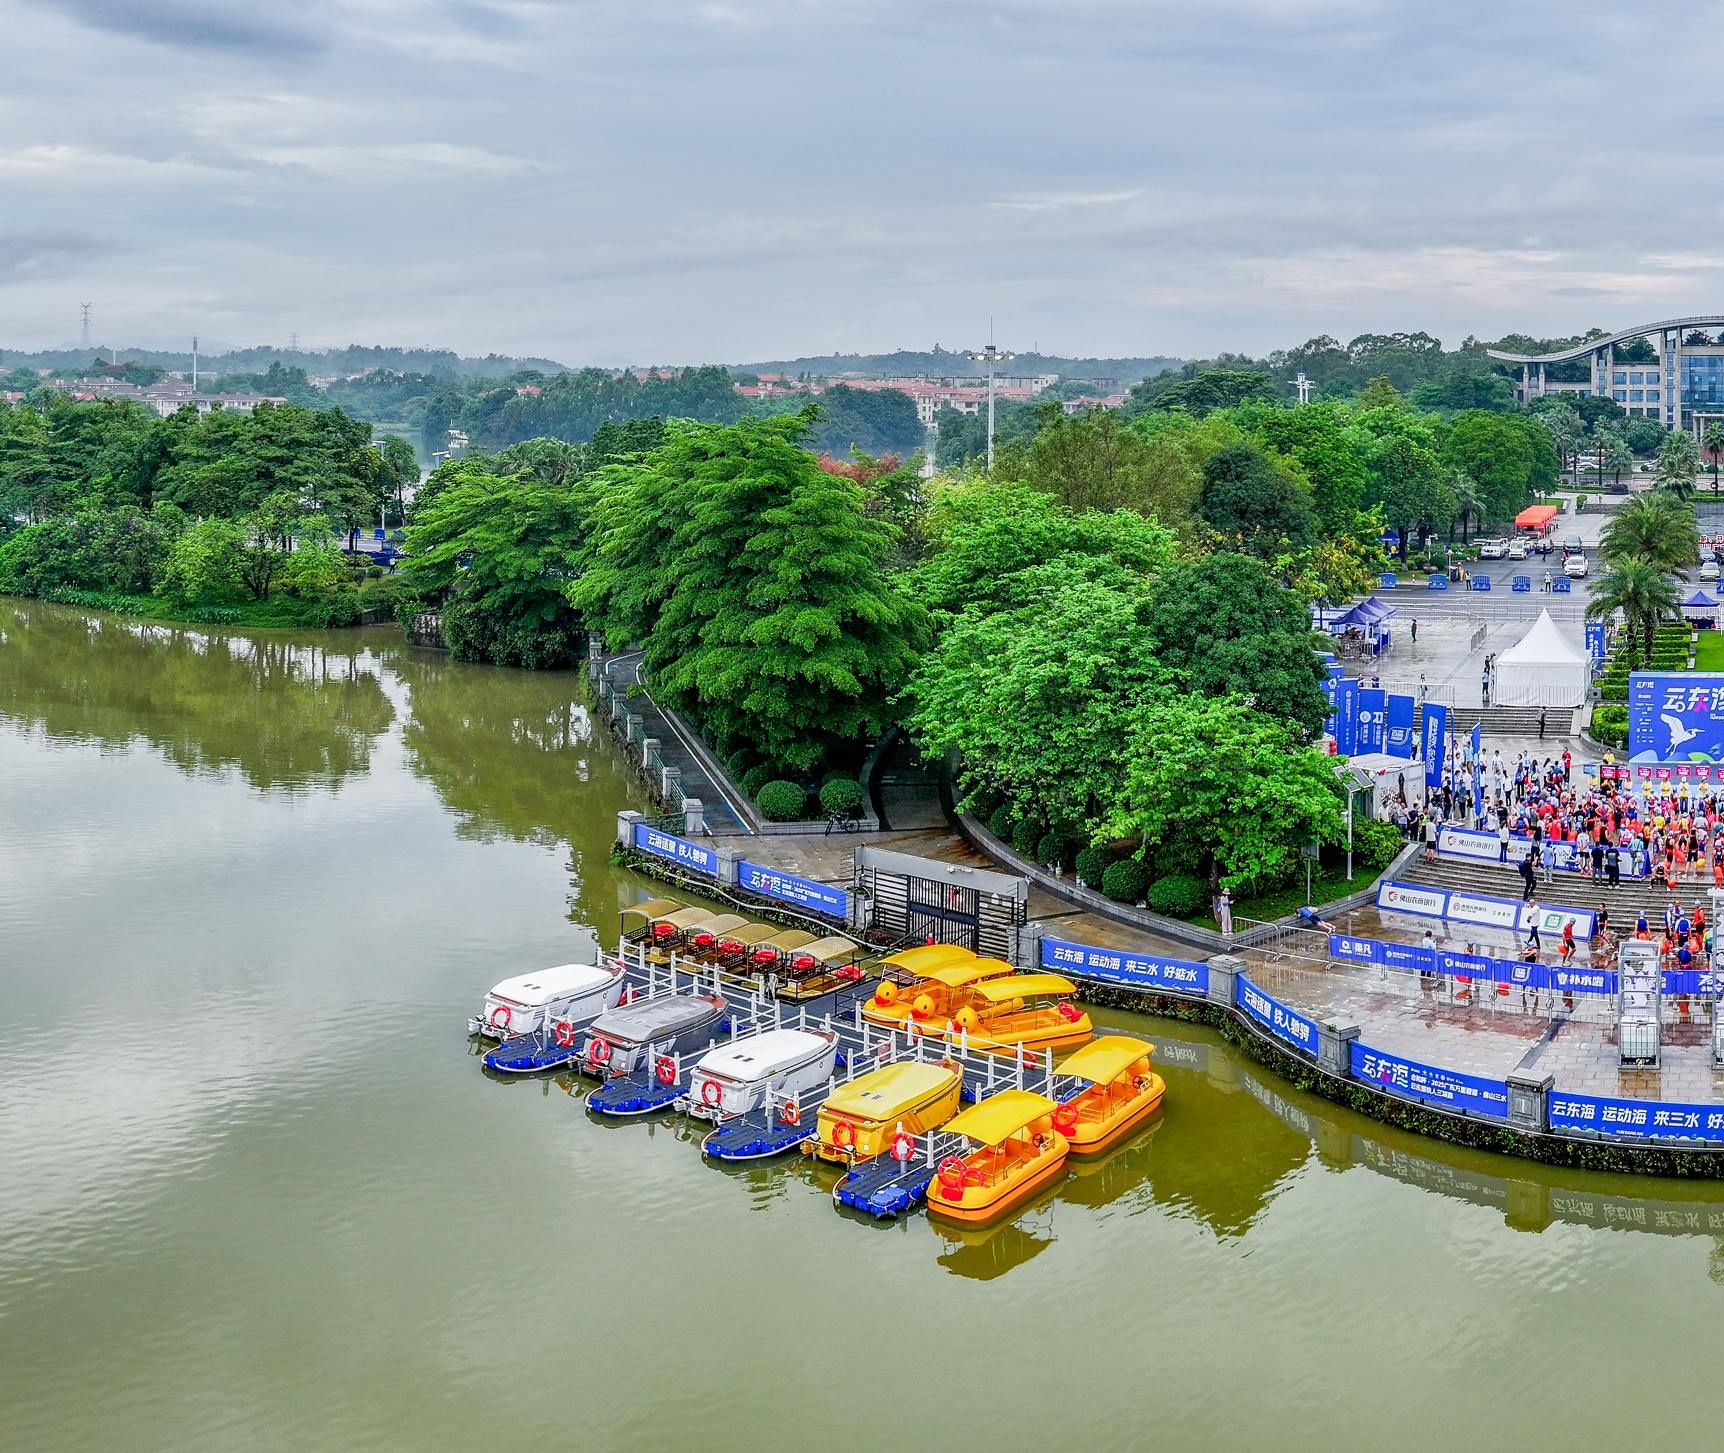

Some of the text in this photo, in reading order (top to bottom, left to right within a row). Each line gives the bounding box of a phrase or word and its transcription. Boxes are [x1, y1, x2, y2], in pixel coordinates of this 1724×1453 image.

[1054, 947, 1085, 964] 云东海
[1088, 953, 1121, 970] 运动海
[1125, 959, 1159, 976] 来三水
[1362, 1054, 1409, 1088] 云东海
[1552, 1100, 1595, 1119] 云东海
[1602, 1106, 1648, 1124] 运动海
[1653, 1110, 1700, 1128] 来三水
